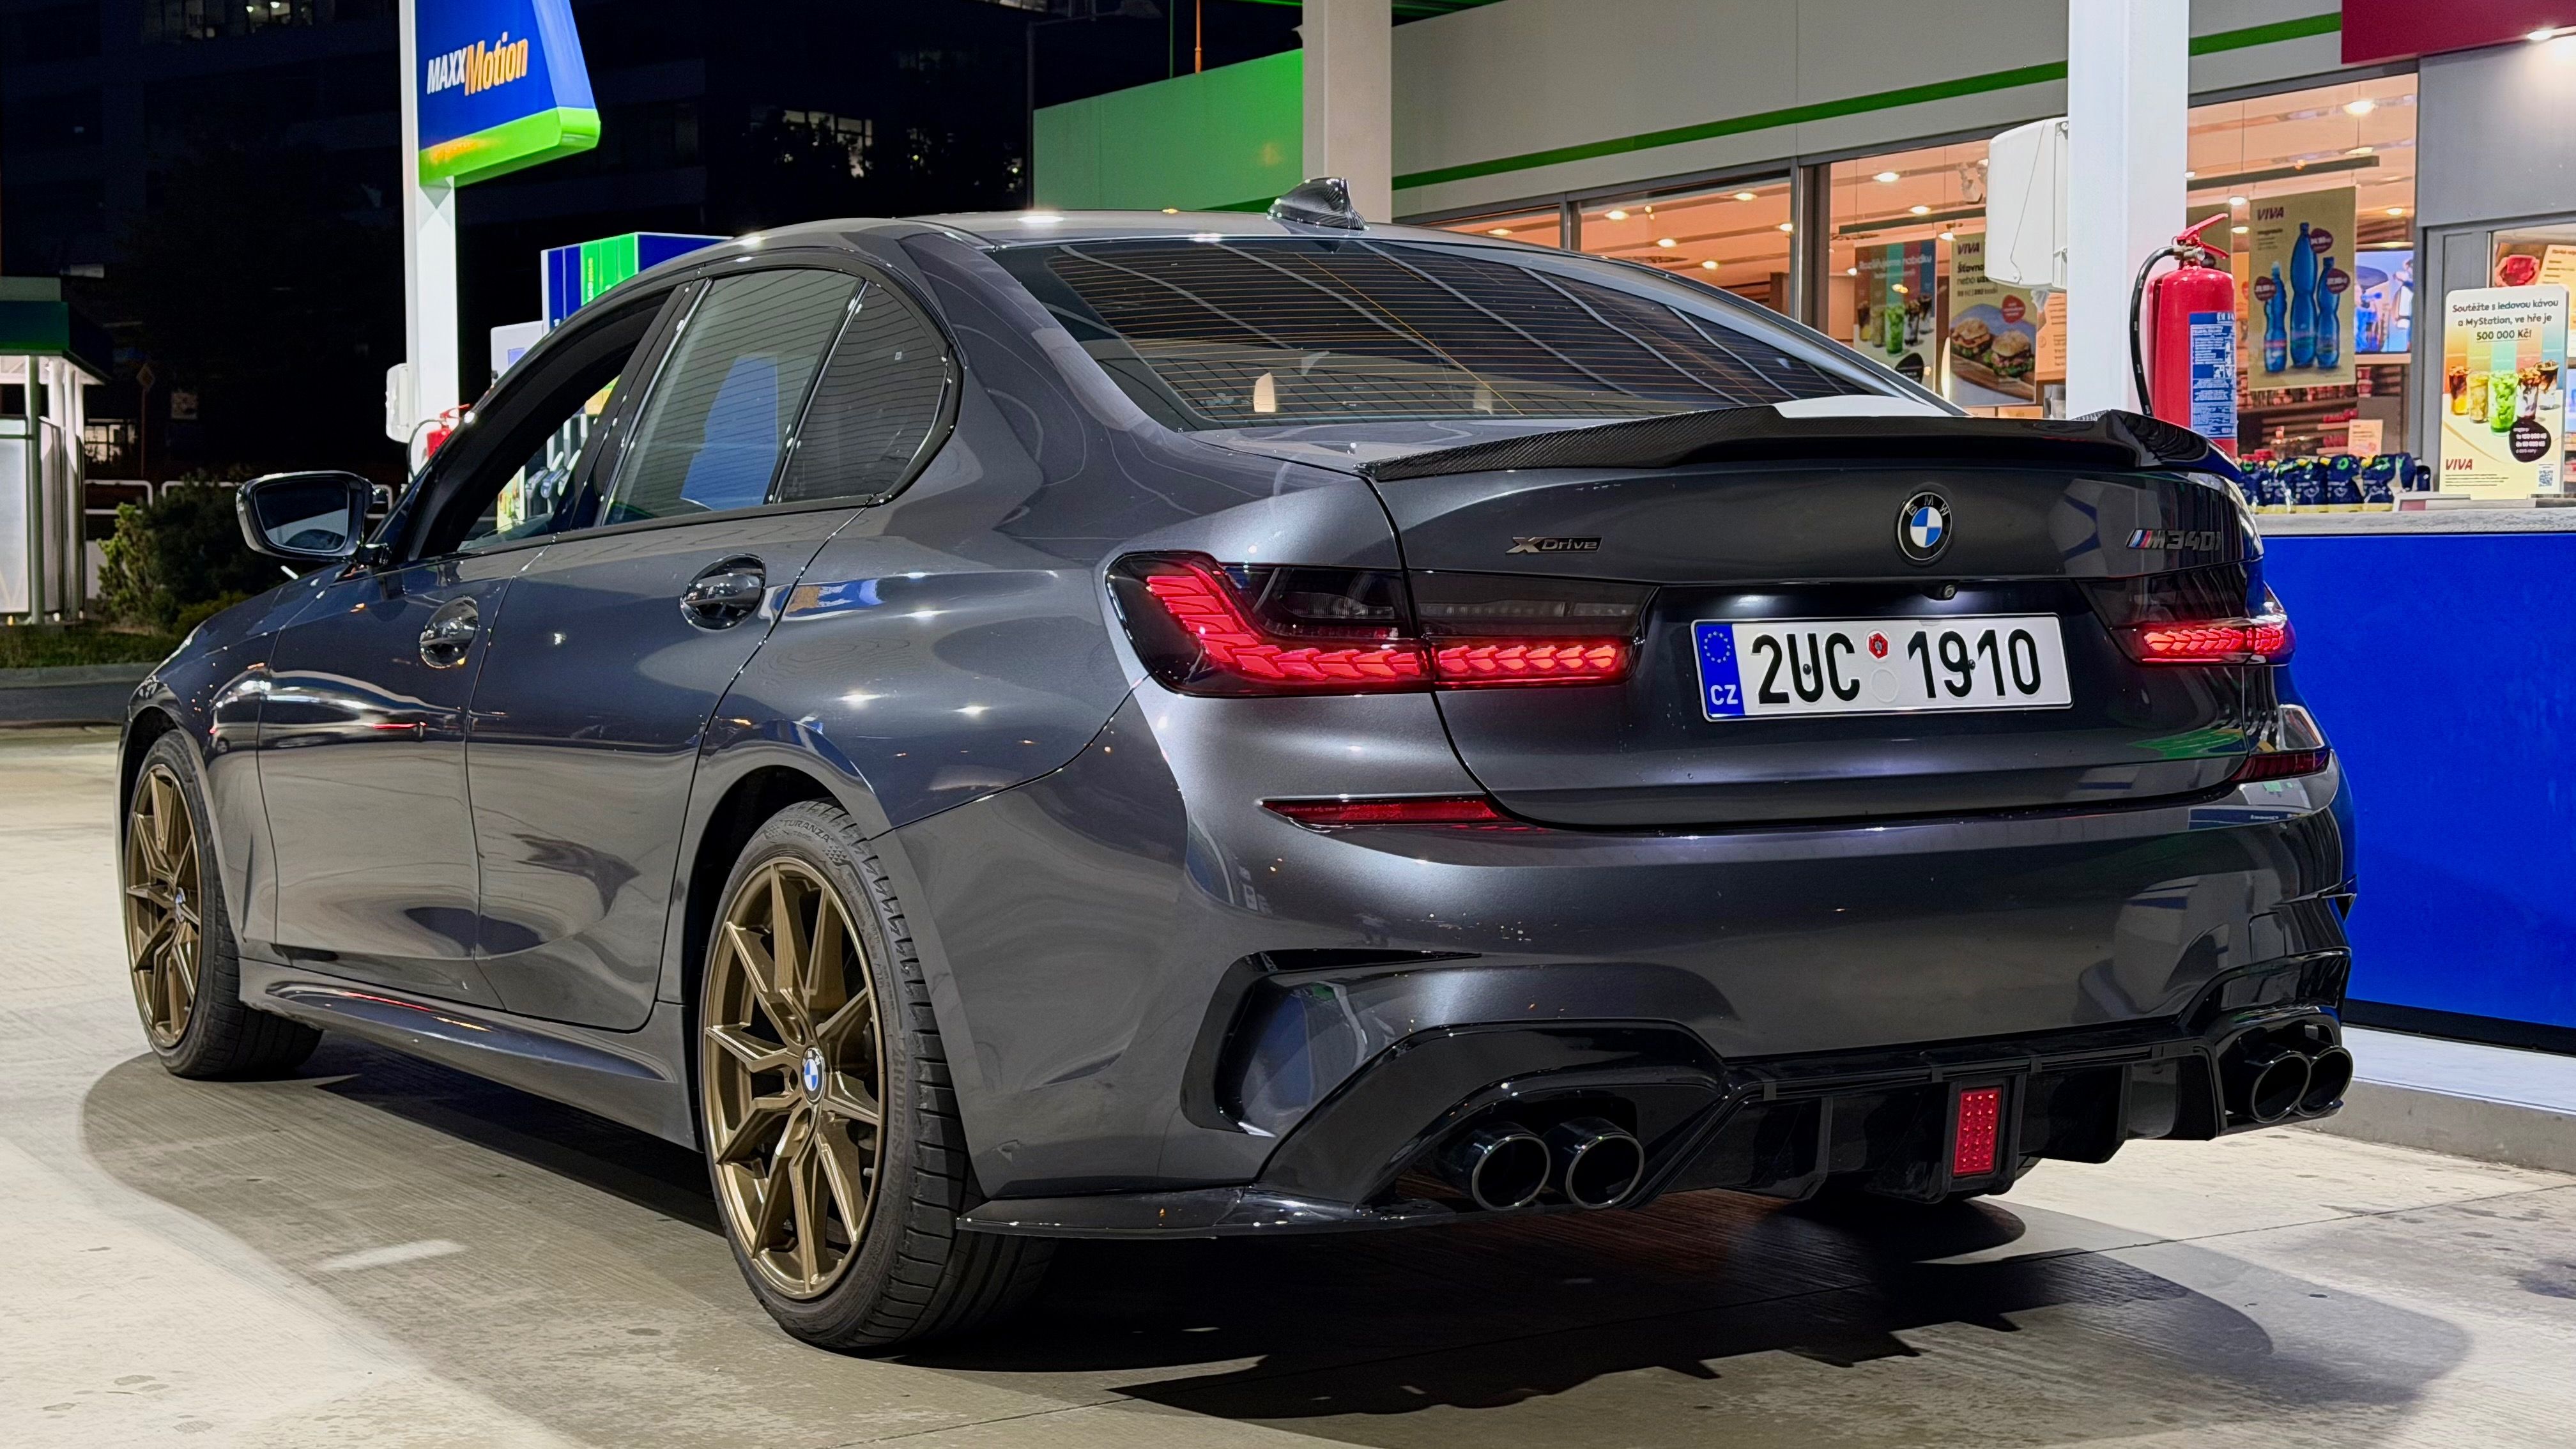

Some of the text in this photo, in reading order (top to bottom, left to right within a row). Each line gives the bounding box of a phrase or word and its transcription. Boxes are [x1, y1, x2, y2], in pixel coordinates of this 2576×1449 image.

[427, 31, 528, 96] MAXXMotion
[2257, 206, 2284, 220] VIVA
[1958, 242, 1980, 255] VIVA
[2452, 302, 2490, 313] Soutěžte
[2497, 302, 2531, 310] ledovou
[2533, 298, 2559, 307] kávou
[2466, 316, 2513, 328] MyStation,
[2527, 313, 2542, 323] hře
[2542, 312, 2552, 325] je
[2476, 328, 2532, 341] 500 000 Kč!
[2446, 458, 2473, 471] VIVA
[1906, 494, 1950, 516] BMW
[1751, 629, 2041, 705] 2UC 1910
[1710, 684, 1738, 705] CZ
[783, 819, 831, 843] TURANZA
